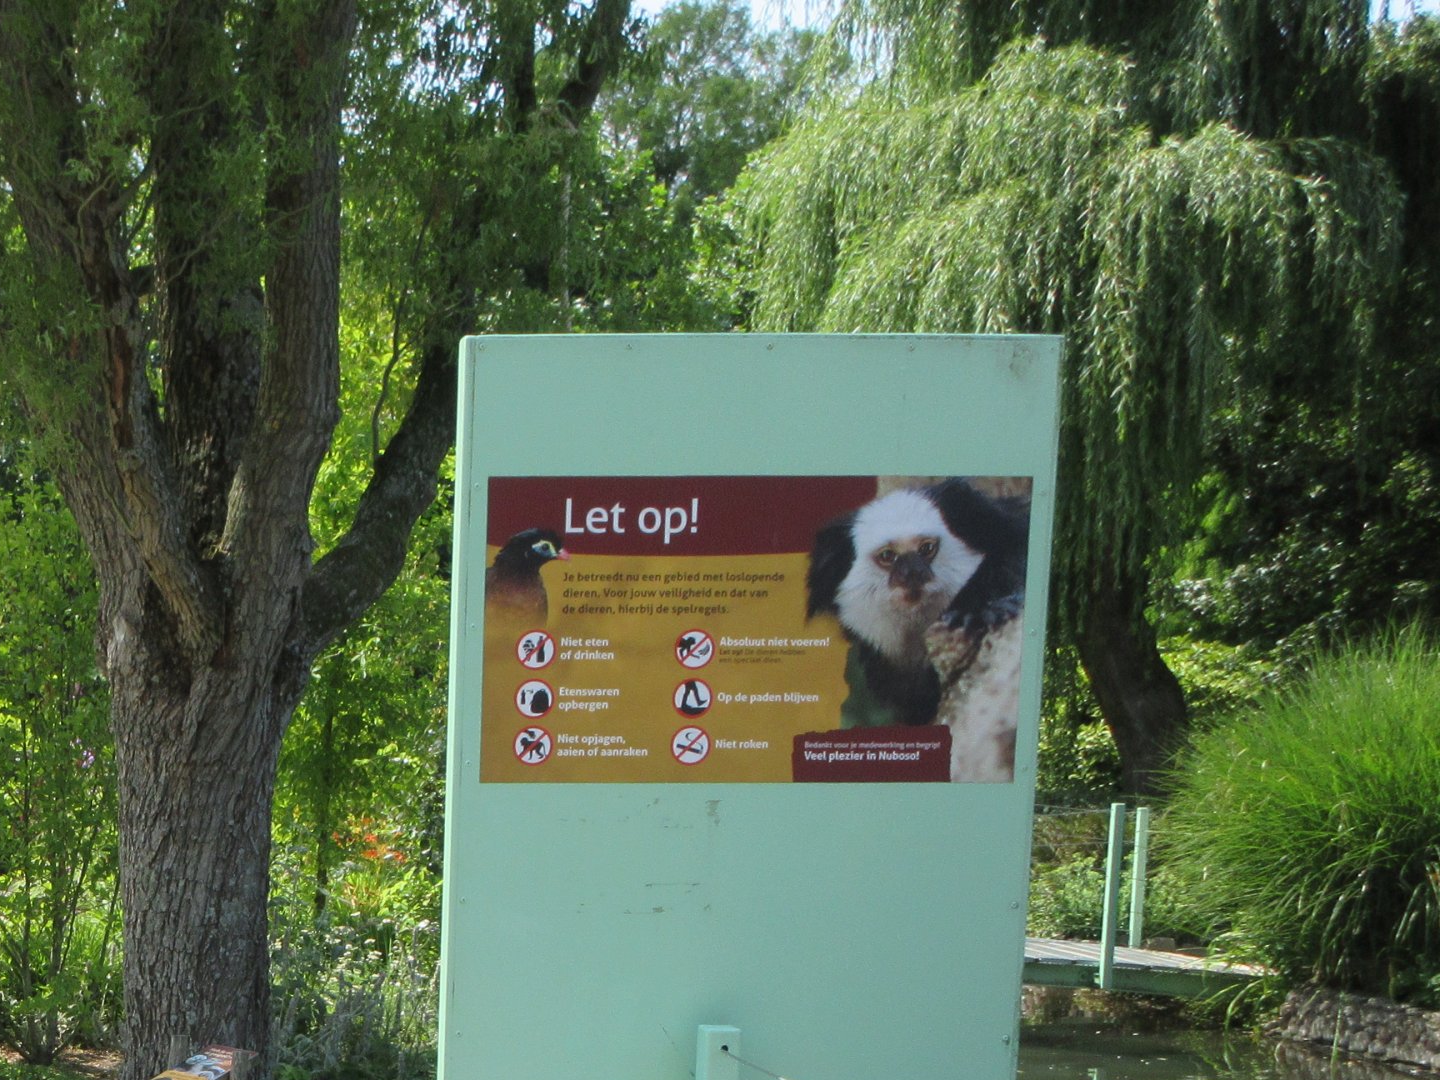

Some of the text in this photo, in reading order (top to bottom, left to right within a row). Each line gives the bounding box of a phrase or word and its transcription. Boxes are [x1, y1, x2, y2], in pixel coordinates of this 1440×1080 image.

[563, 498, 699, 544] Let op!
[563, 572, 785, 584] Je betreedt nu een gebied met loslopende
[563, 588, 768, 600] dieren. Voor jouw veiligheid en dat van
[562, 604, 729, 616] de dieren, hierbij de spelregels.
[560, 637, 609, 647] Niet eten
[720, 636, 830, 647] Absoluut niet voeren!
[560, 650, 615, 660] of drinken
[559, 687, 620, 696] Etenswaren
[717, 692, 819, 704] Op de paden blijven
[558, 700, 609, 712] opbergen
[557, 734, 626, 746] Niet opjagen,
[715, 739, 768, 749] Niet roken
[804, 741, 832, 749] Bedankt
[850, 741, 857, 750] je
[557, 747, 648, 757] aaien of aanraken
[804, 751, 920, 762] Veel plezier in Nuboso!
